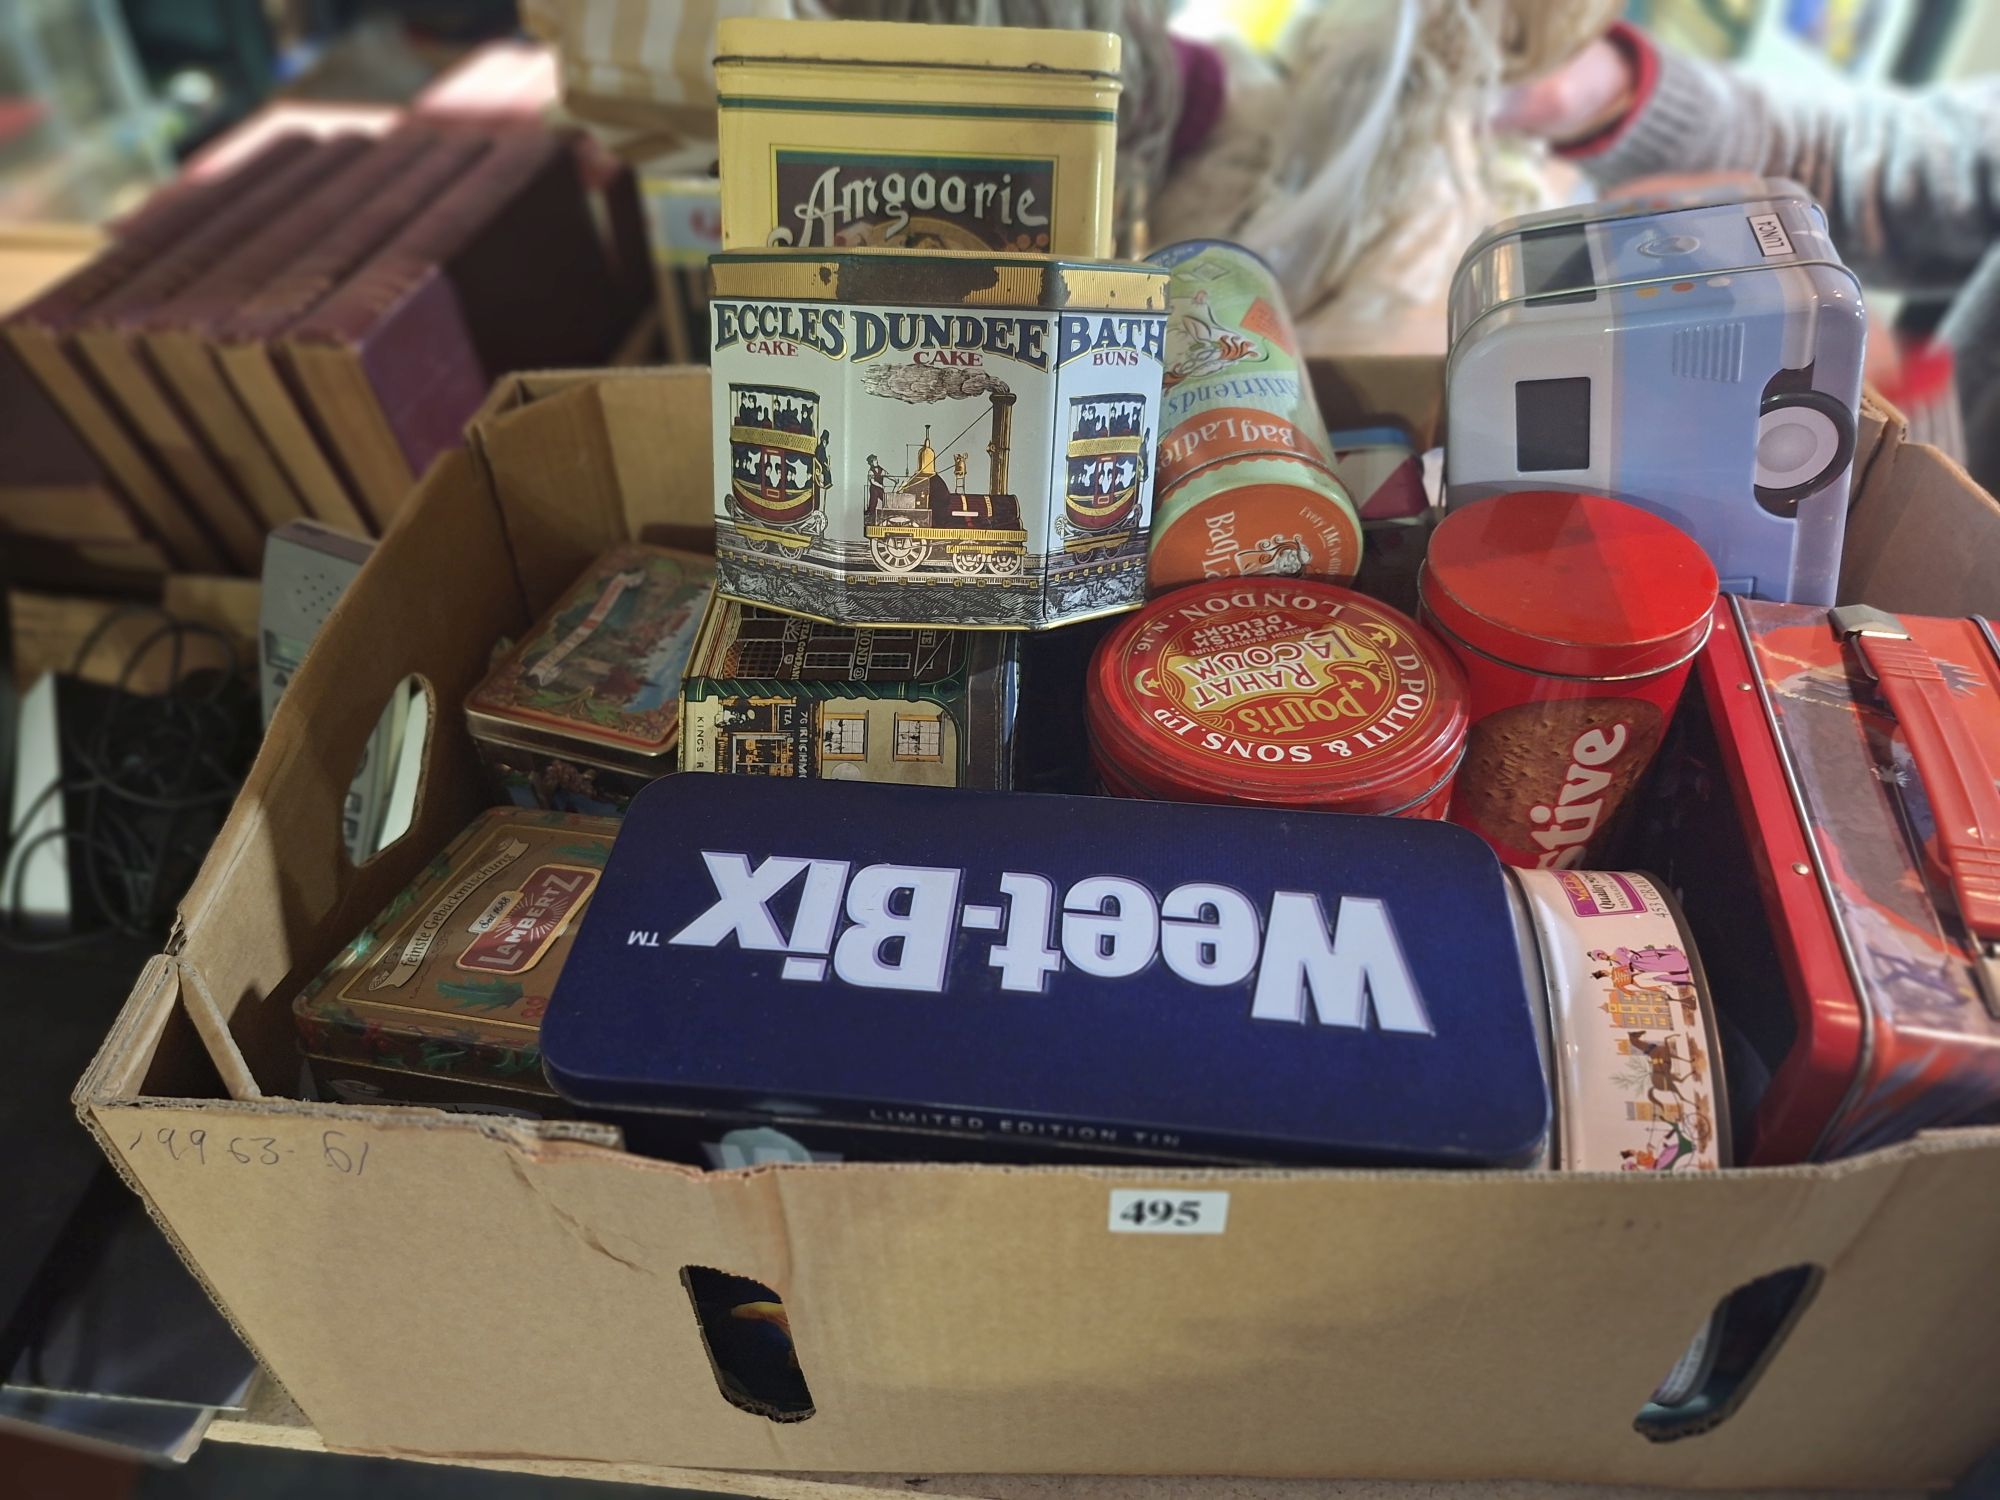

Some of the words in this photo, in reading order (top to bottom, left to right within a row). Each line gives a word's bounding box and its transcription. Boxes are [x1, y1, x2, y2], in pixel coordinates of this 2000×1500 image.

[768, 167, 1048, 247] Amgoorie
[714, 304, 847, 361] ECCLES
[746, 342, 798, 357] CAKE
[850, 311, 1049, 374] DUNDEE
[1054, 317, 1167, 373] BATH
[913, 351, 983, 367] CAKE
[1093, 351, 1139, 366] BUNS
[1240, 419, 1296, 447] Bag
[1205, 511, 1240, 557] Bag
[1192, 614, 1282, 640] DELIGHT
[1194, 621, 1297, 648] TURKISH
[1177, 629, 1358, 682] LACOUM
[1191, 636, 1267, 656] MANUFACTURE
[1191, 662, 1320, 709] RAHAT
[784, 708, 792, 725] TEA
[1321, 739, 1352, 757] &
[478, 874, 584, 966] LAMBERTZ
[401, 930, 431, 967] feinste
[668, 850, 1436, 1036] Weet-Bix
[869, 1109, 984, 1129] LIMITED
[1000, 1119, 1117, 1141] EDITION
[1133, 1132, 1180, 1147] TIN
[1119, 1199, 1201, 1227] 495
